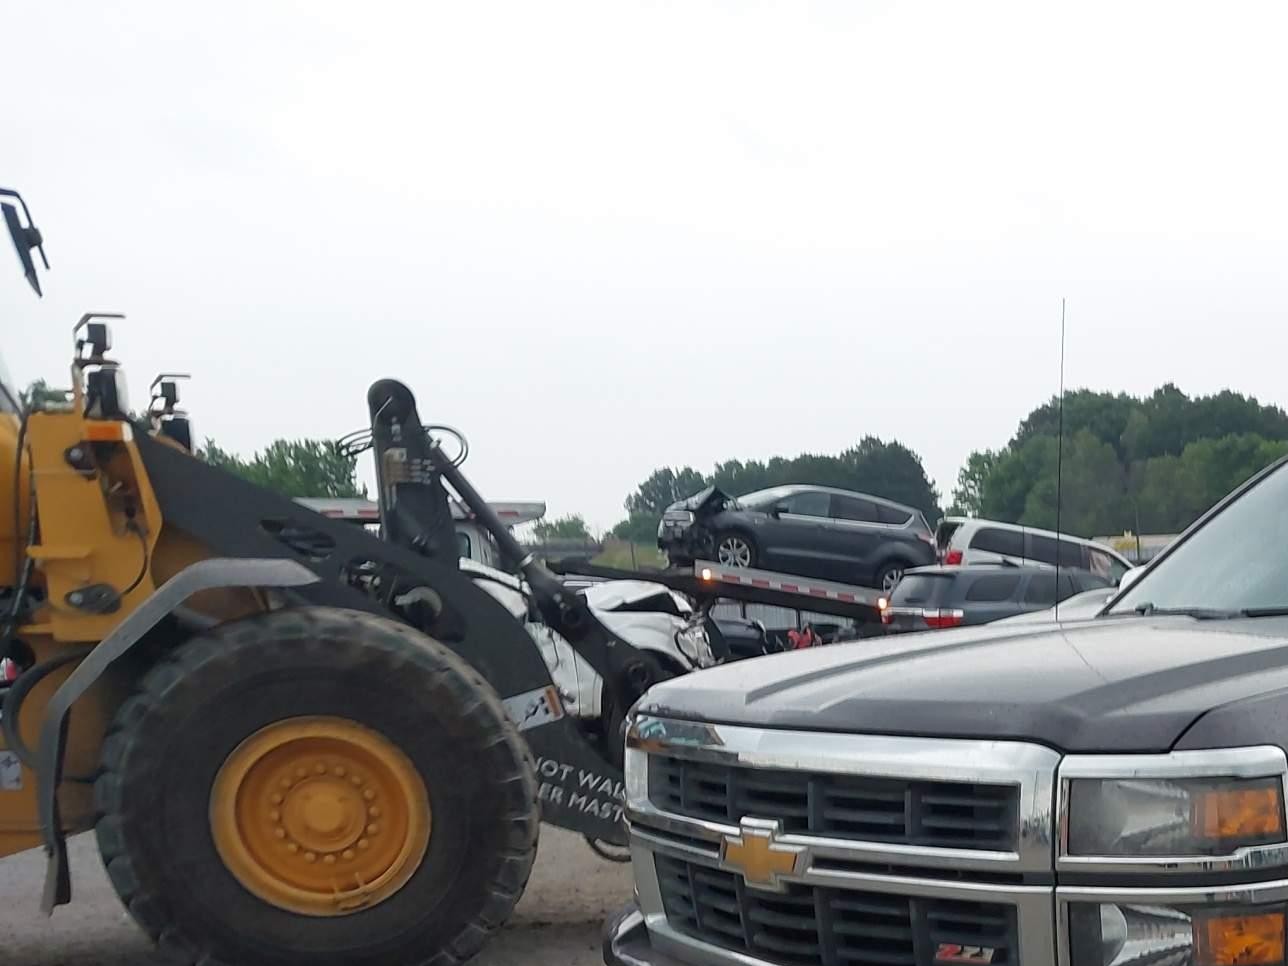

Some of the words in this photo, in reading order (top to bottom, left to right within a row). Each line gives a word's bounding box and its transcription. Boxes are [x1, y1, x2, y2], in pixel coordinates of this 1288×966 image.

[537, 781, 563, 805] ER
[578, 769, 625, 801] WAL
[935, 943, 994, 965] Z71
